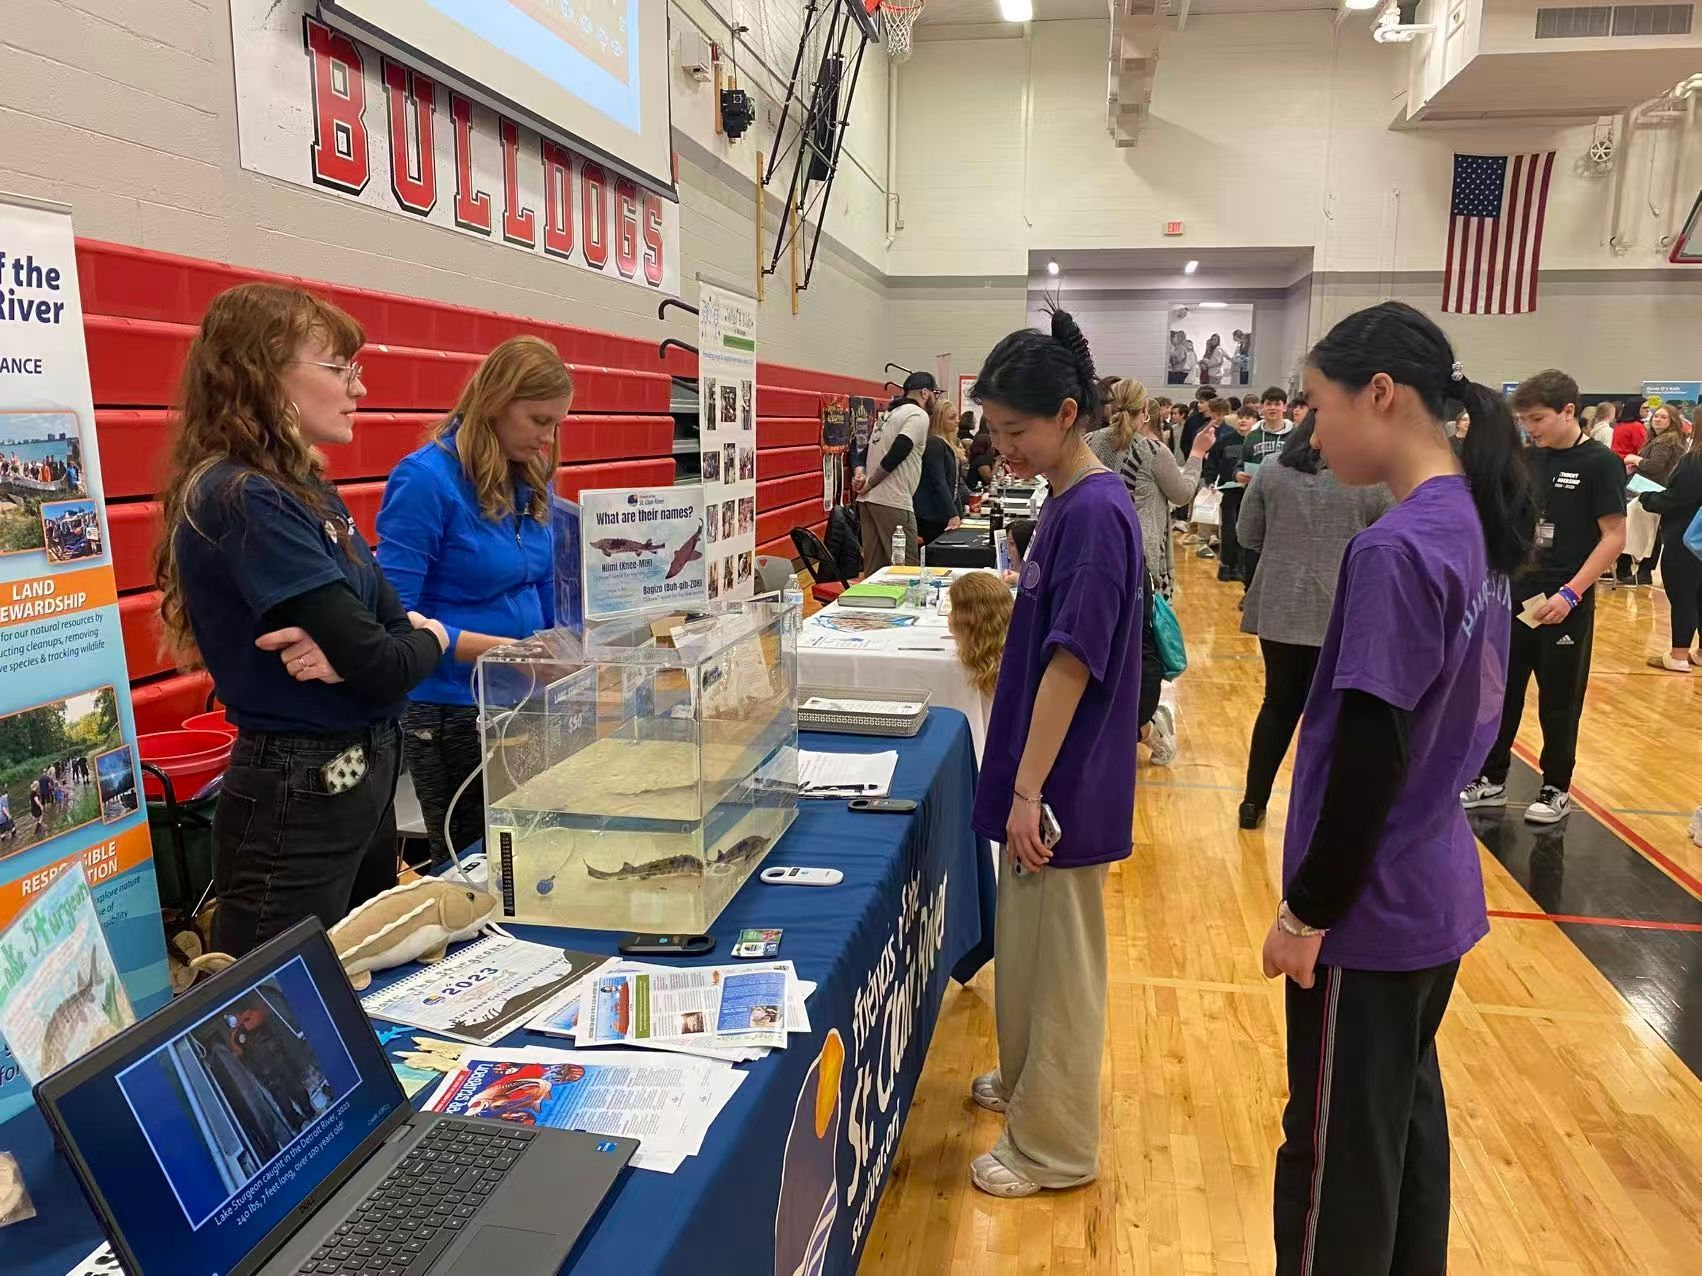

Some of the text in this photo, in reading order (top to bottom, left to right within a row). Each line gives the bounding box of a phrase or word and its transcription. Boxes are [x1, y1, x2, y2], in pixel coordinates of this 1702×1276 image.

[302, 15, 664, 288] BULLDOGS
[12, 255, 60, 291] the
[596, 506, 694, 525] What are their names?
[12, 580, 55, 601] LAND
[0, 592, 87, 623] EWARDSHIP
[1, 612, 104, 643] for our natural resources by
[26, 637, 64, 652] cleanups,
[65, 628, 99, 643] removing
[9, 657, 38, 673] species
[40, 654, 47, 664] &
[48, 647, 79, 662] tracking
[80, 640, 105, 653] wildlife
[119, 876, 141, 892] nature
[442, 967, 499, 996] 2023
[214, 1207, 233, 1226] Lake
[232, 1180, 263, 1211] Sturgeon
[262, 1160, 285, 1182] caught
[290, 1145, 301, 1158] the
[300, 1126, 322, 1148] Detroit
[321, 1113, 338, 1130] River,
[236, 1211, 250, 1225] 240
[248, 1200, 263, 1214] lbs,
[265, 1183, 280, 1198] feet
[278, 1170, 296, 1186] long,
[294, 1158, 308, 1171] over
[308, 1147, 319, 1159] 100
[319, 1132, 335, 1150] years
